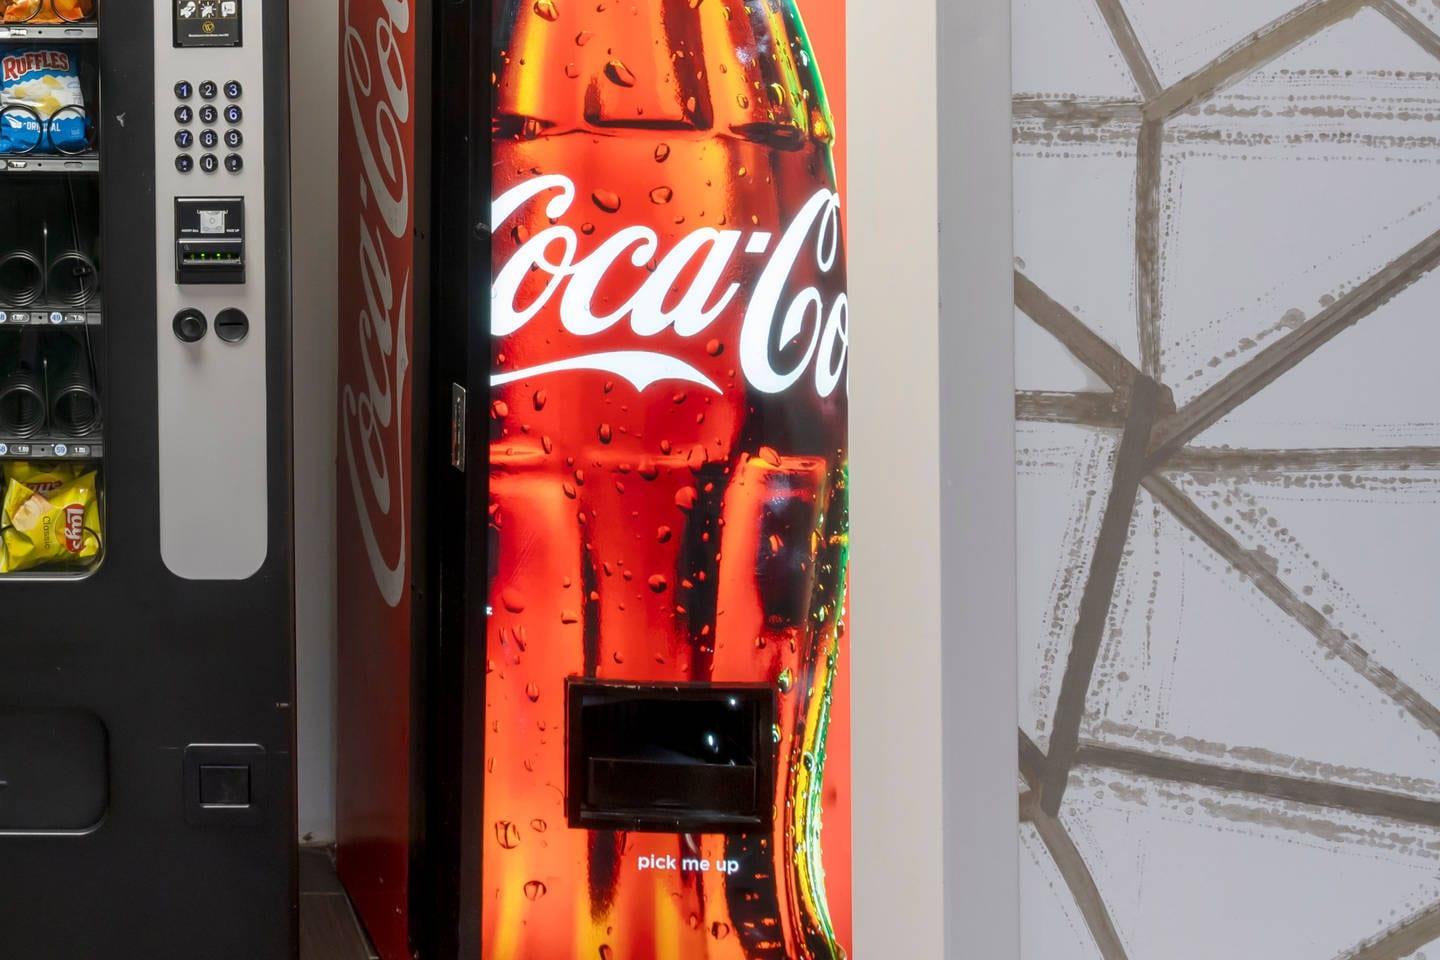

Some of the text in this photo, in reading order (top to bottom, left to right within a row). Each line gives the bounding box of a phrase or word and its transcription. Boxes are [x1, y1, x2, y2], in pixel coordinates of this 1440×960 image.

[2, 51, 69, 81] RUFFLES
[181, 85, 187, 96] 1
[205, 85, 212, 96] 2
[229, 84, 238, 96] 3
[180, 109, 188, 121] 4
[205, 108, 213, 121] 5
[229, 108, 238, 120] 6
[181, 133, 188, 145] 7
[205, 133, 213, 145] 8
[230, 133, 238, 145] 9
[205, 158, 213, 169] 0
[42, 516, 51, 549] Classic
[638, 854, 739, 873] pick me up
